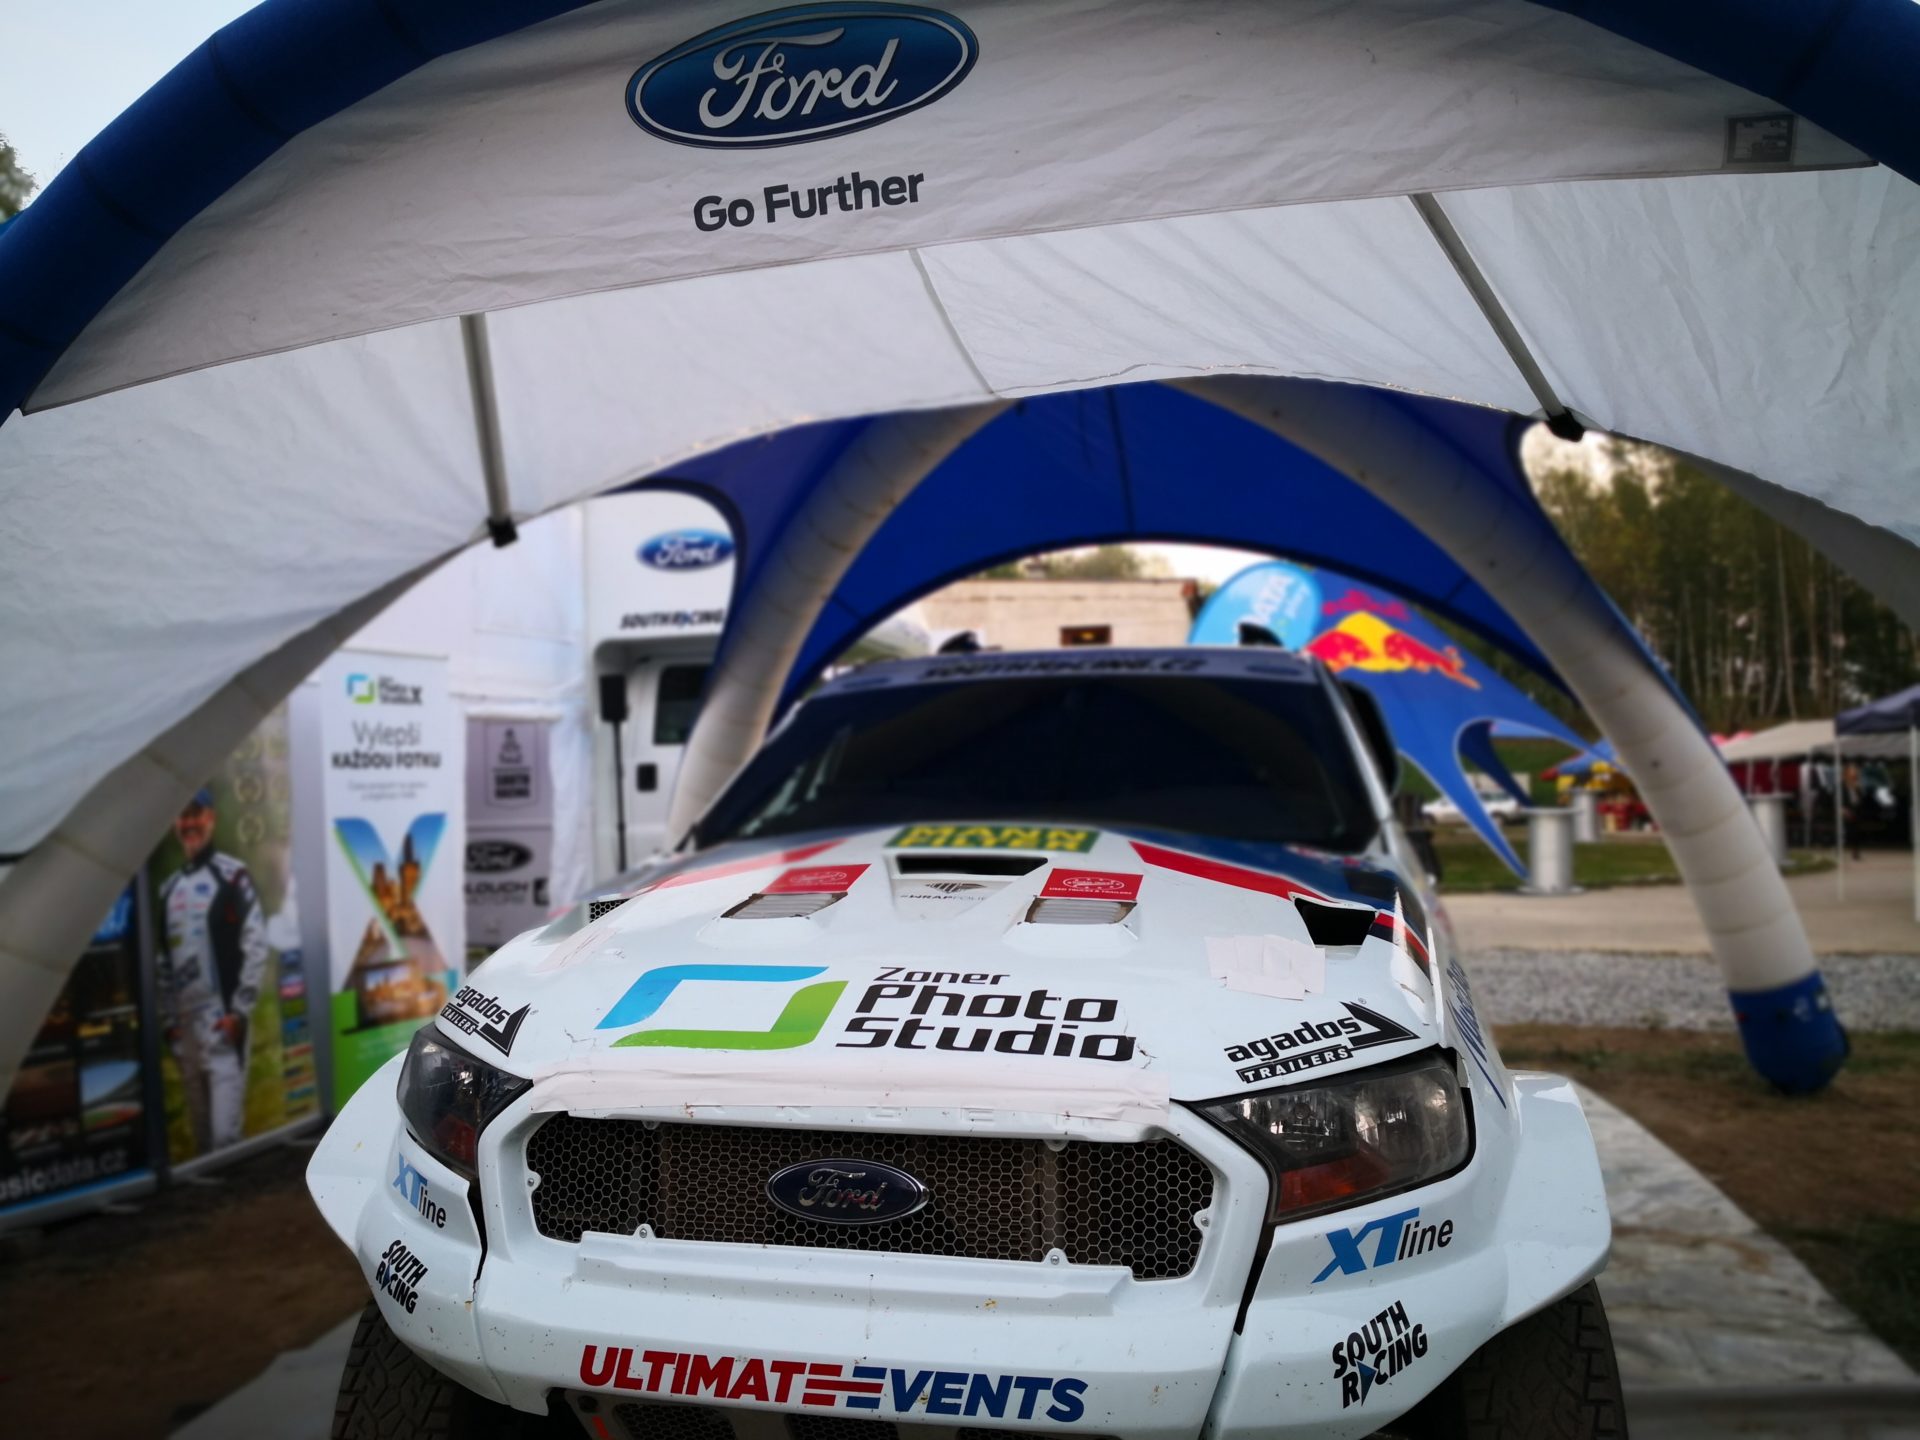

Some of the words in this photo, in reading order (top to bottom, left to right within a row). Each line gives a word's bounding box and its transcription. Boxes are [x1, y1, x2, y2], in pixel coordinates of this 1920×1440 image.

[699, 27, 900, 129] Ford
[693, 195, 755, 232] Go
[764, 171, 925, 223] Further
[655, 536, 720, 565] Ford
[909, 826, 1088, 839] MANN
[873, 966, 1010, 985] Zoner
[441, 1006, 477, 1035] TRAILERS
[455, 985, 511, 1025] agados
[855, 984, 1119, 1023] Photo
[835, 1016, 1136, 1062] Studio
[1224, 1016, 1362, 1062] agados
[1242, 1047, 1350, 1083] TRAILERS
[392, 1152, 446, 1228] XTline
[799, 1167, 888, 1212] Ford
[382, 1239, 428, 1288] SOUTH
[1311, 1207, 1453, 1284] XTline
[1332, 1300, 1410, 1379] SOUTH
